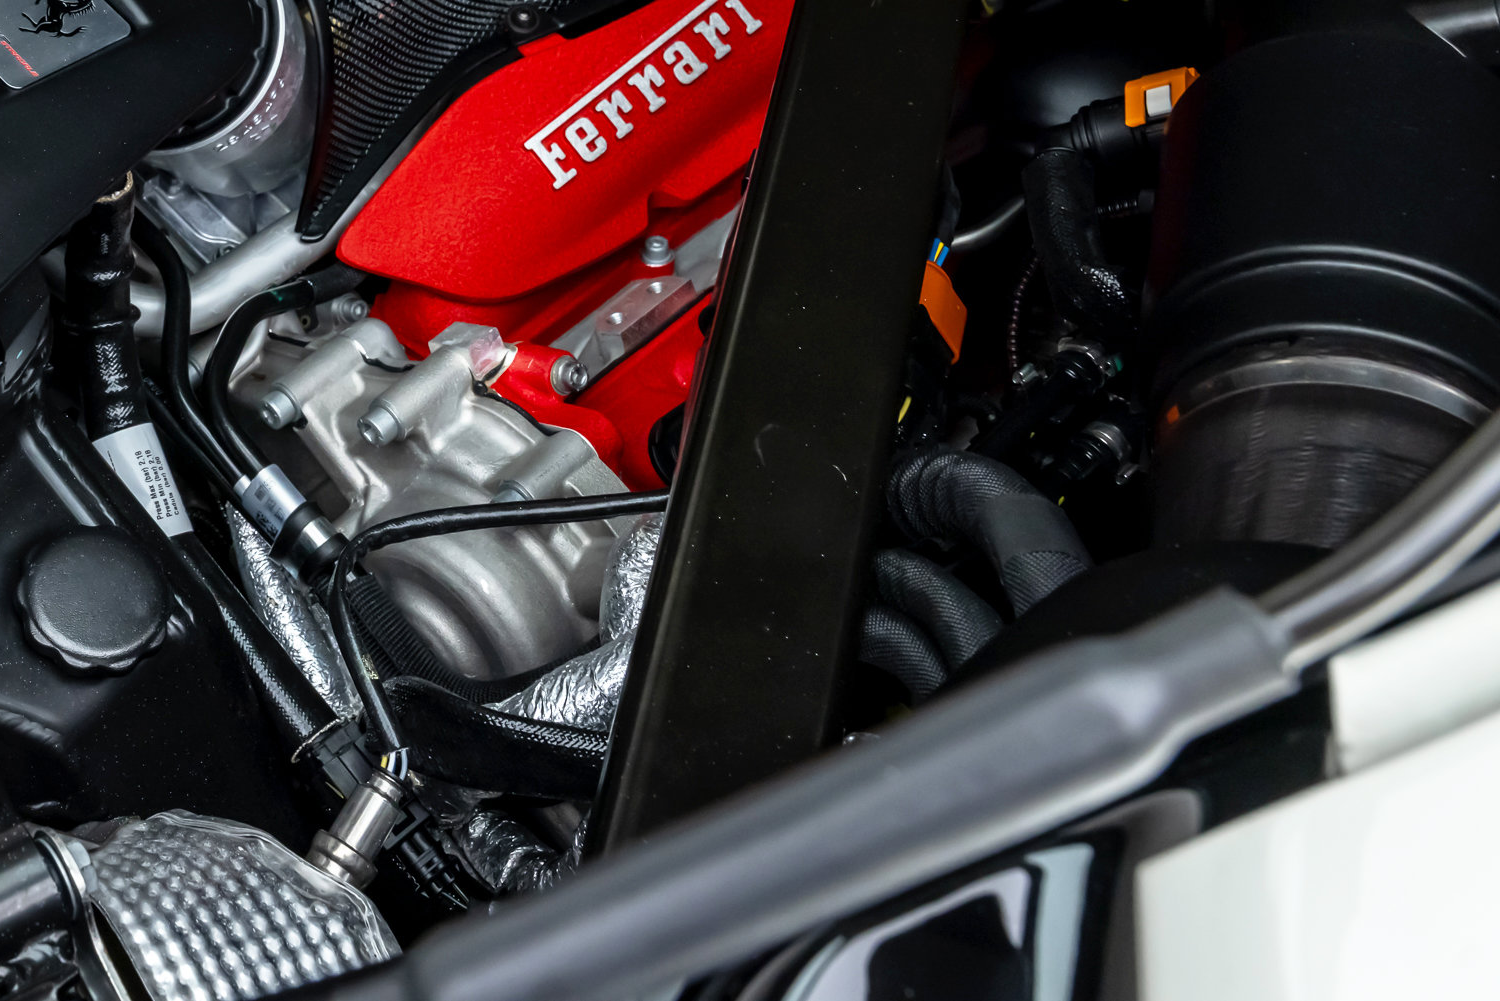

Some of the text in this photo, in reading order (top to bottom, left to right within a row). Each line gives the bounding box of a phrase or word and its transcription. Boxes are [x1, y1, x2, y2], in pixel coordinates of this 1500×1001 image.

[134, 450, 145, 466] 2.18
[144, 449, 155, 464] 2.18
[155, 456, 163, 471] 0.00
[149, 485, 157, 499] Max
[154, 501, 164, 520] Press
[163, 498, 173, 517] Press
